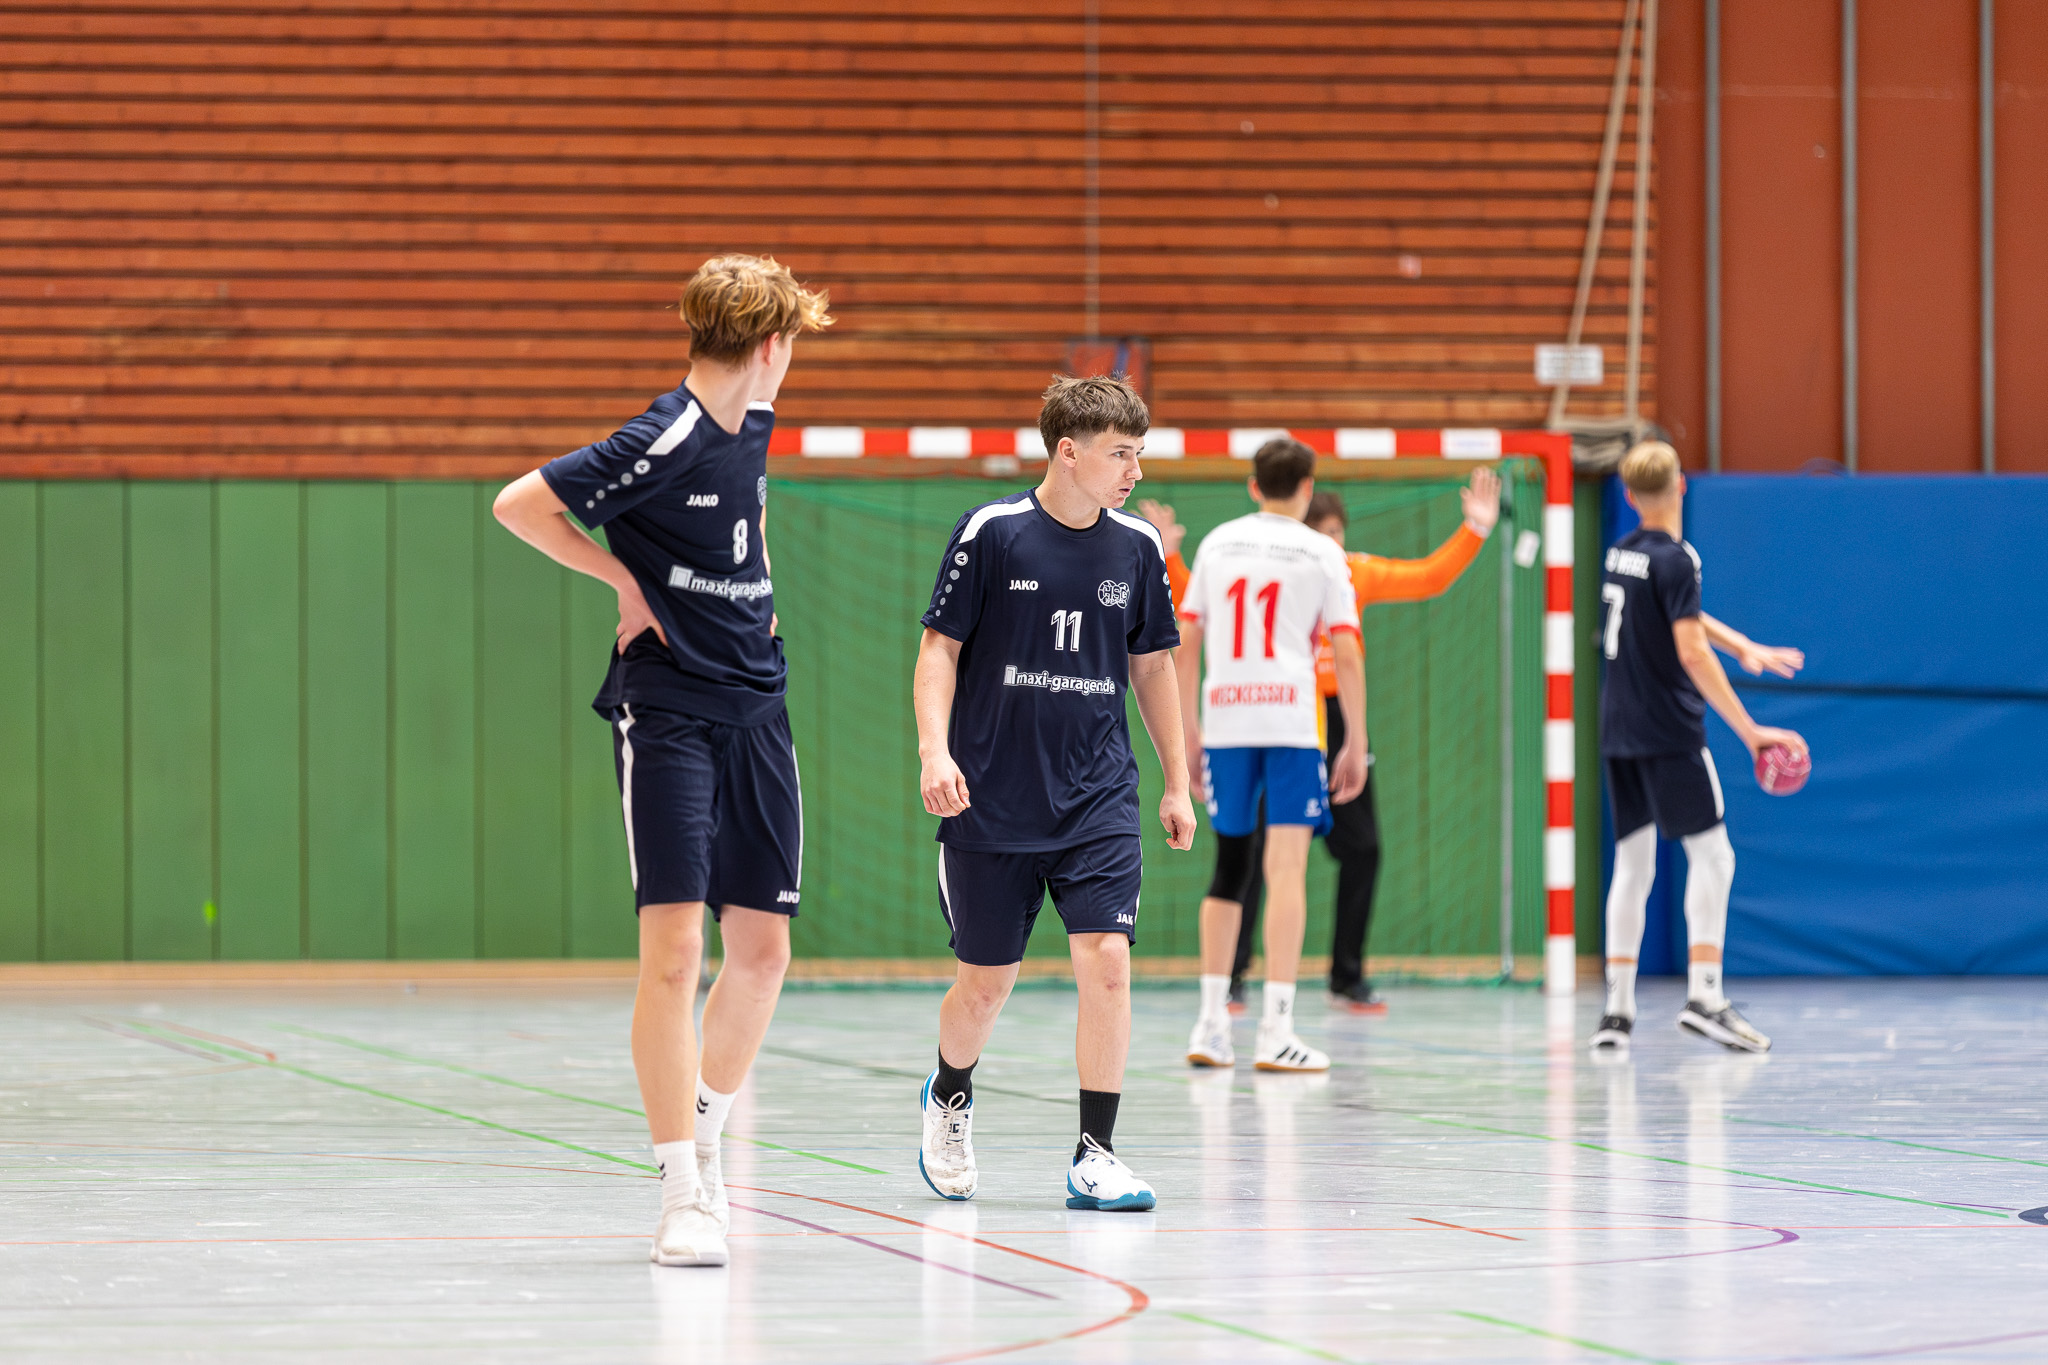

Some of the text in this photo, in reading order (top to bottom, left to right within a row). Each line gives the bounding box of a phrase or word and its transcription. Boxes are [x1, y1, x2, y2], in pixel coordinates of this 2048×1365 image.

[686, 494, 719, 507] JAKO
[733, 518, 748, 565] 8
[1009, 579, 1039, 591] JAKO
[1051, 609, 1083, 652] 11
[1227, 576, 1281, 660] 11
[1602, 582, 1625, 660] 7
[776, 890, 801, 904] JAKO
[1116, 912, 1134, 926] JAK
